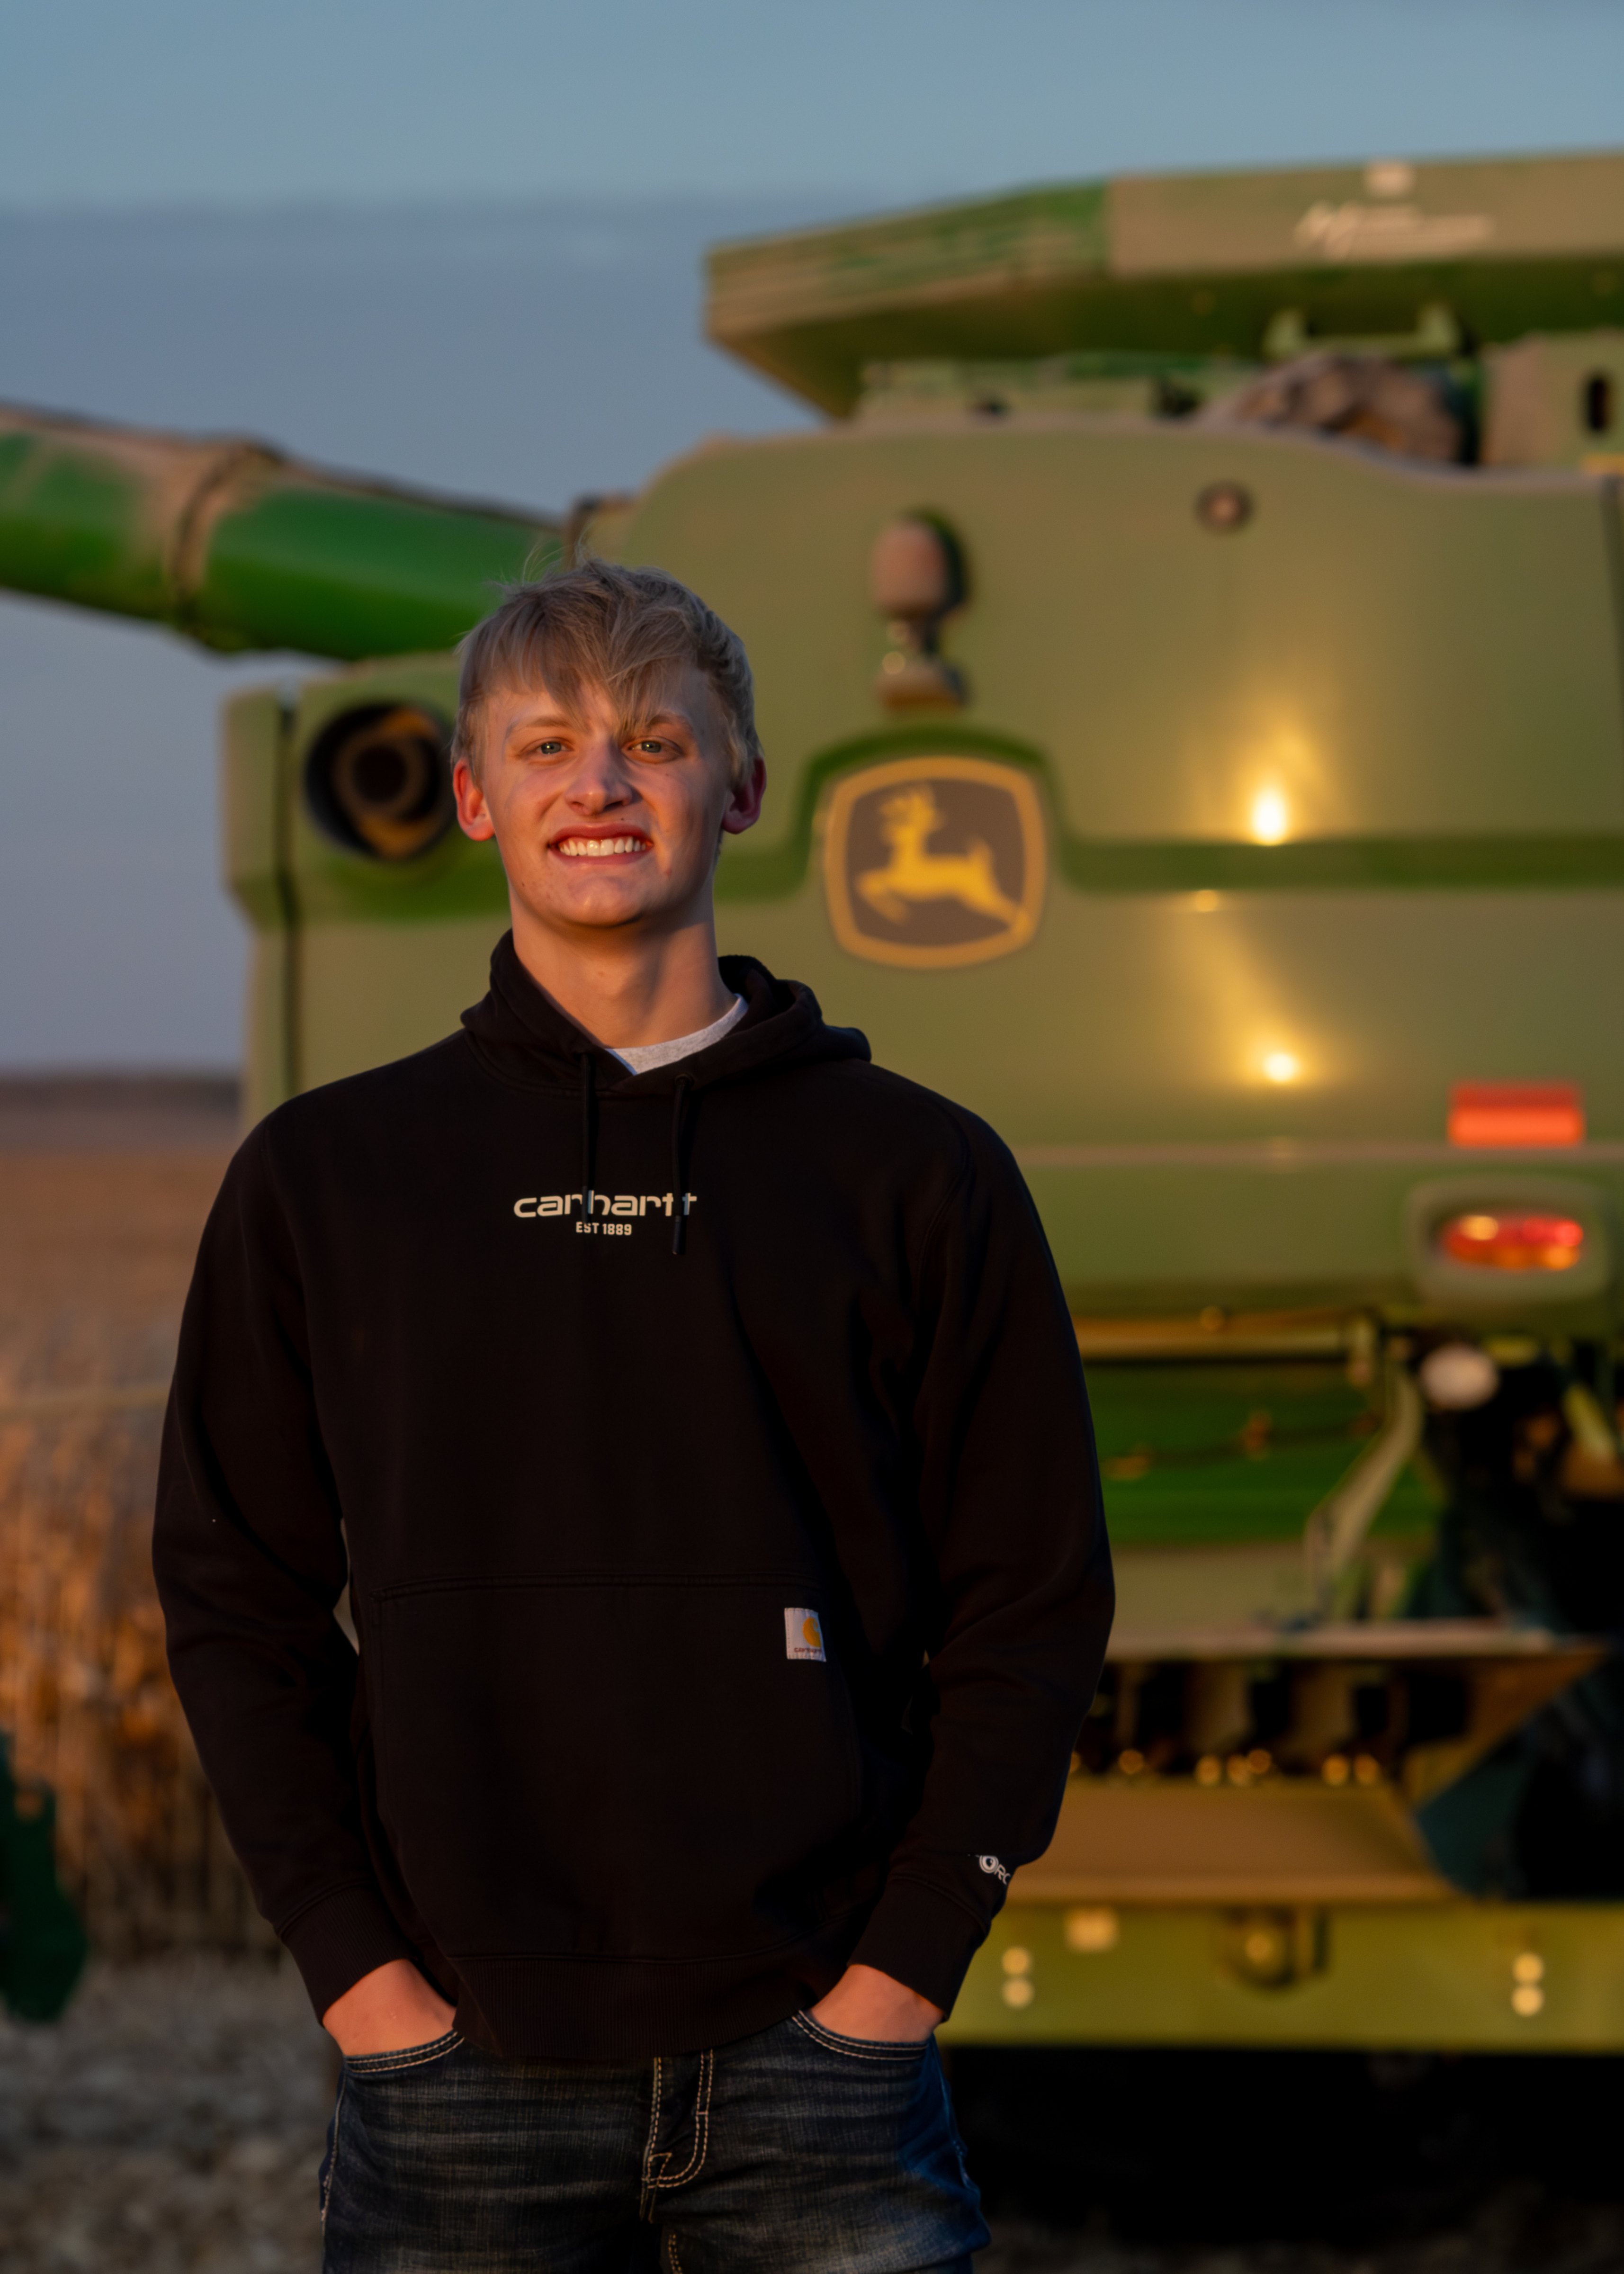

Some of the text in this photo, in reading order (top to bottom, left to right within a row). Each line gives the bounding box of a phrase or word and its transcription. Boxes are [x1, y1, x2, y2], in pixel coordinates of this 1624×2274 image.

[514, 1190, 697, 1218] carhartt
[576, 1221, 632, 1236] EST 1889
